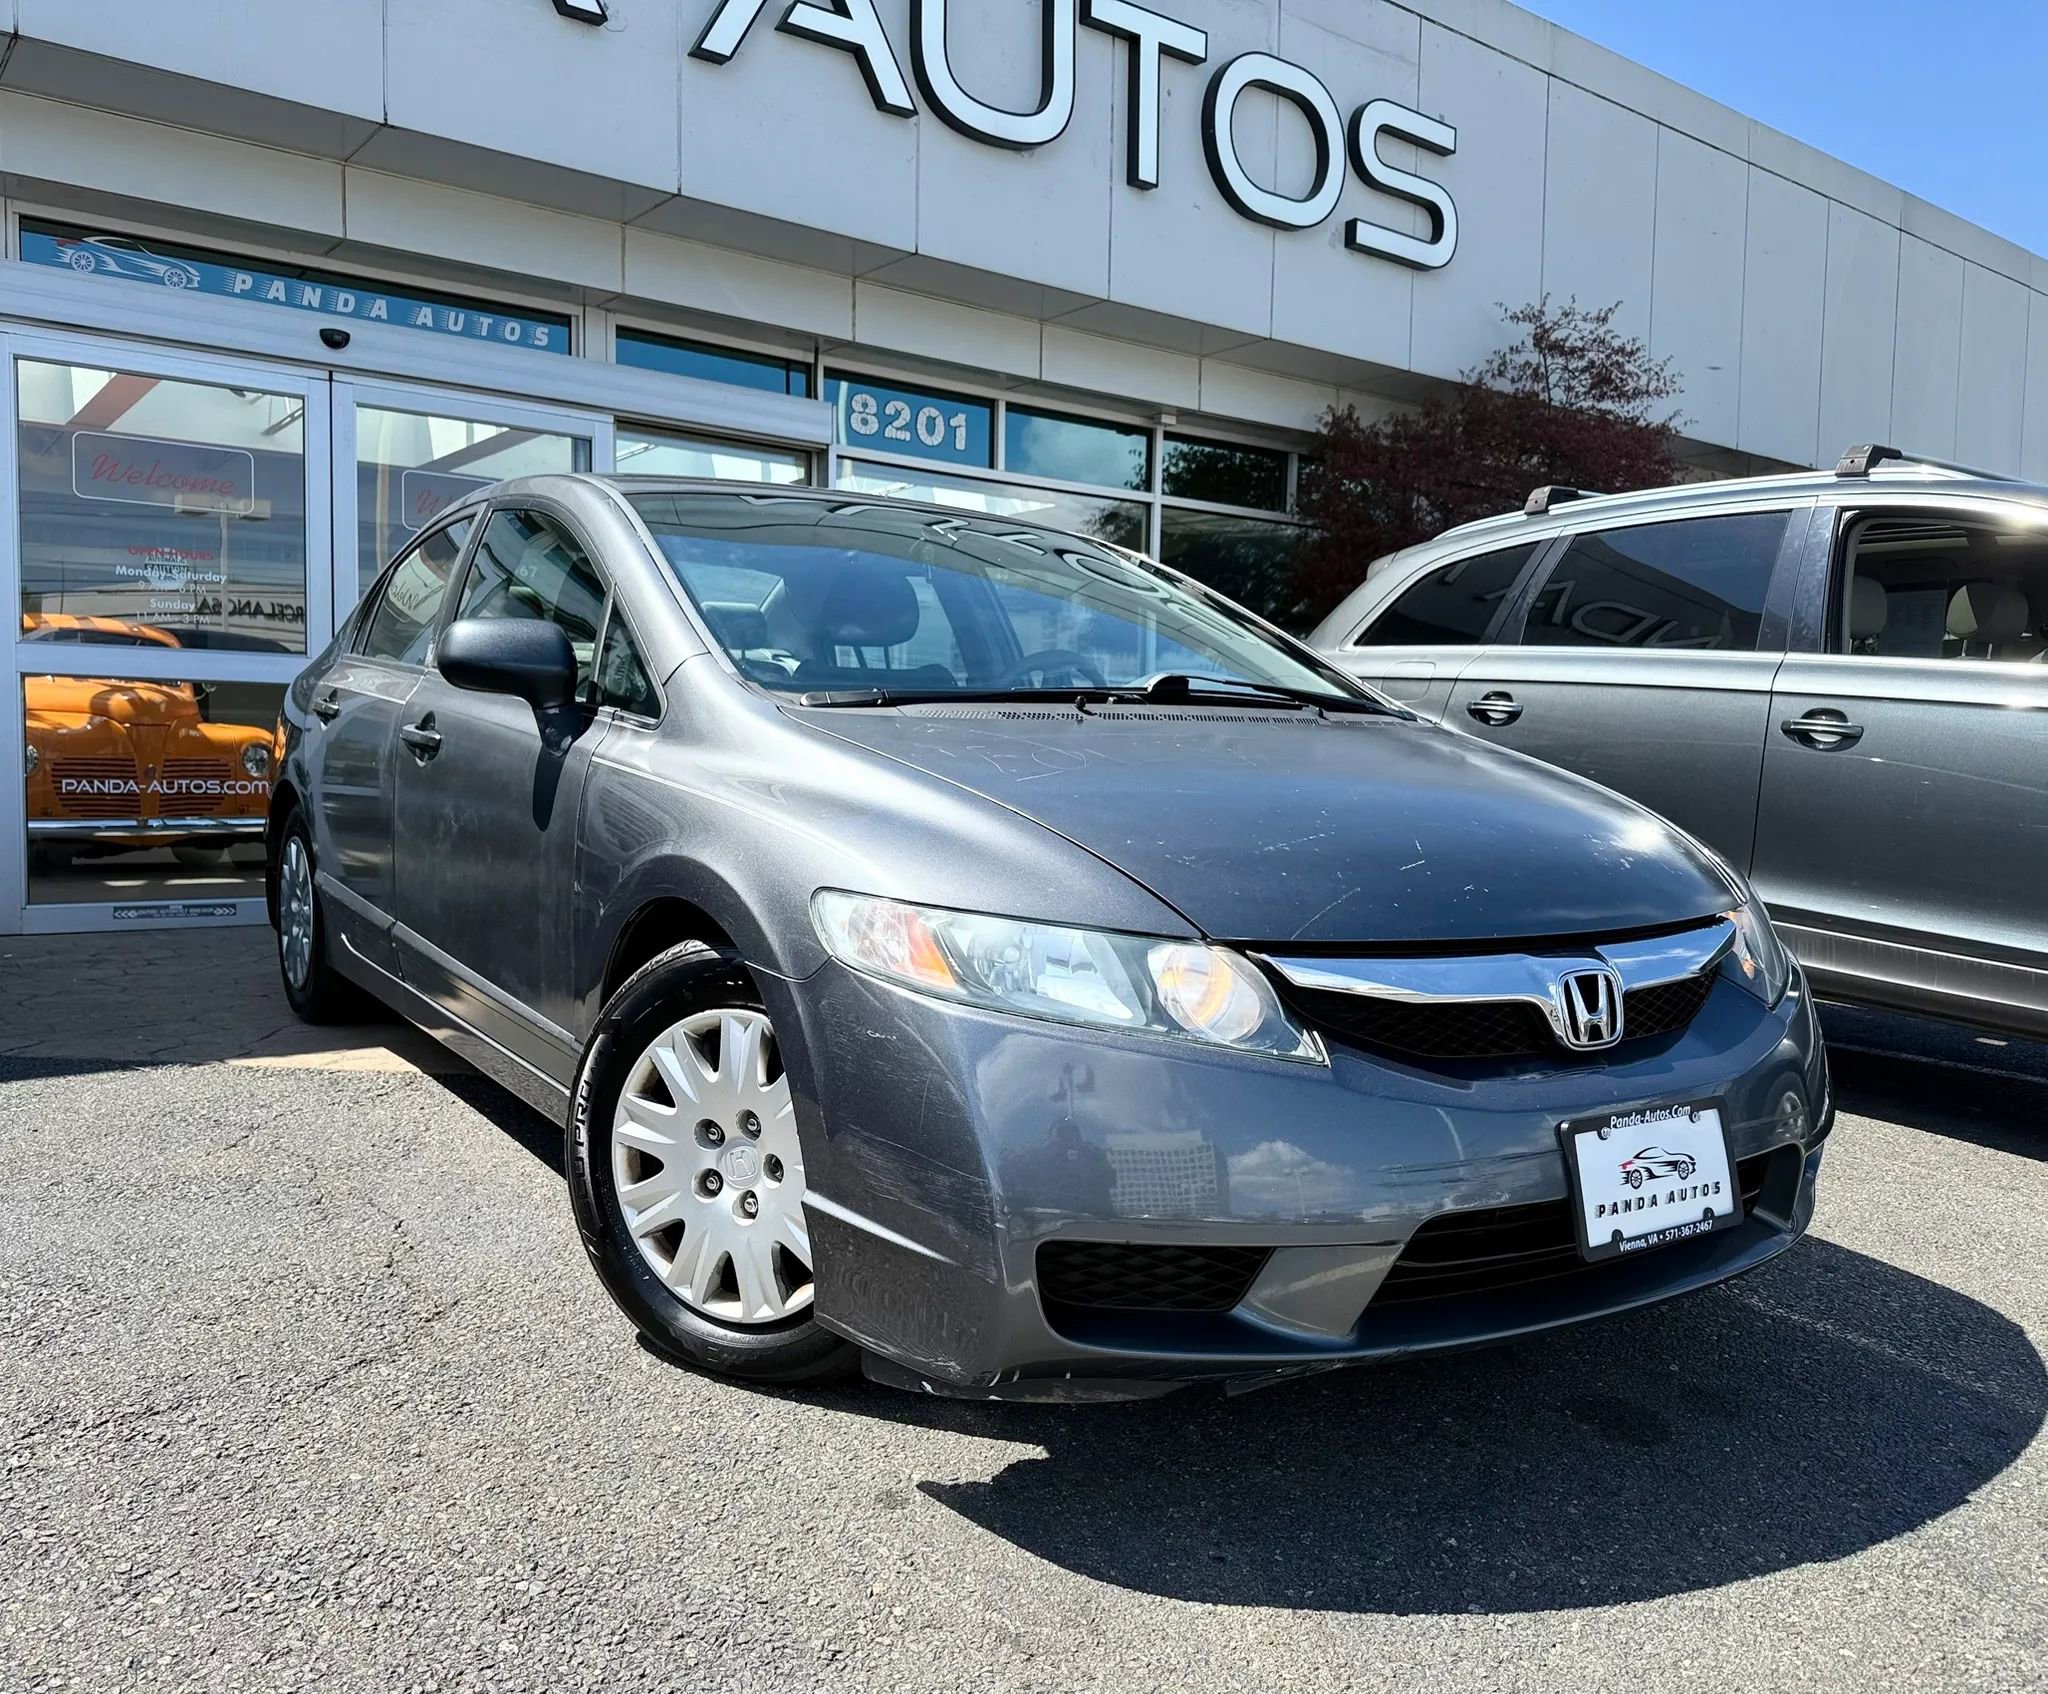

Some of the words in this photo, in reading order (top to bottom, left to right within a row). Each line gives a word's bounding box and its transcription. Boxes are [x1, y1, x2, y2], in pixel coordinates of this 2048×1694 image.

[230, 272, 388, 320] PANDA
[411, 306, 549, 347] AUTOS
[849, 393, 967, 451] 8201
[90, 452, 236, 495] Welcome
[150, 599, 195, 612] Sunday
[190, 584, 206, 595] PM
[136, 612, 147, 621] 11
[152, 613, 171, 622] AM
[182, 615, 189, 623] 3
[193, 615, 210, 624] PM
[1610, 1104, 1691, 1129] Panda-Autos.Com
[1597, 1194, 1658, 1218] PANDA
[1667, 1181, 1721, 1204] AUTOS
[1619, 1238, 1647, 1253] Vienna,
[1647, 1233, 1660, 1244] VA
[1665, 1219, 1713, 1241] 571-367-2467
